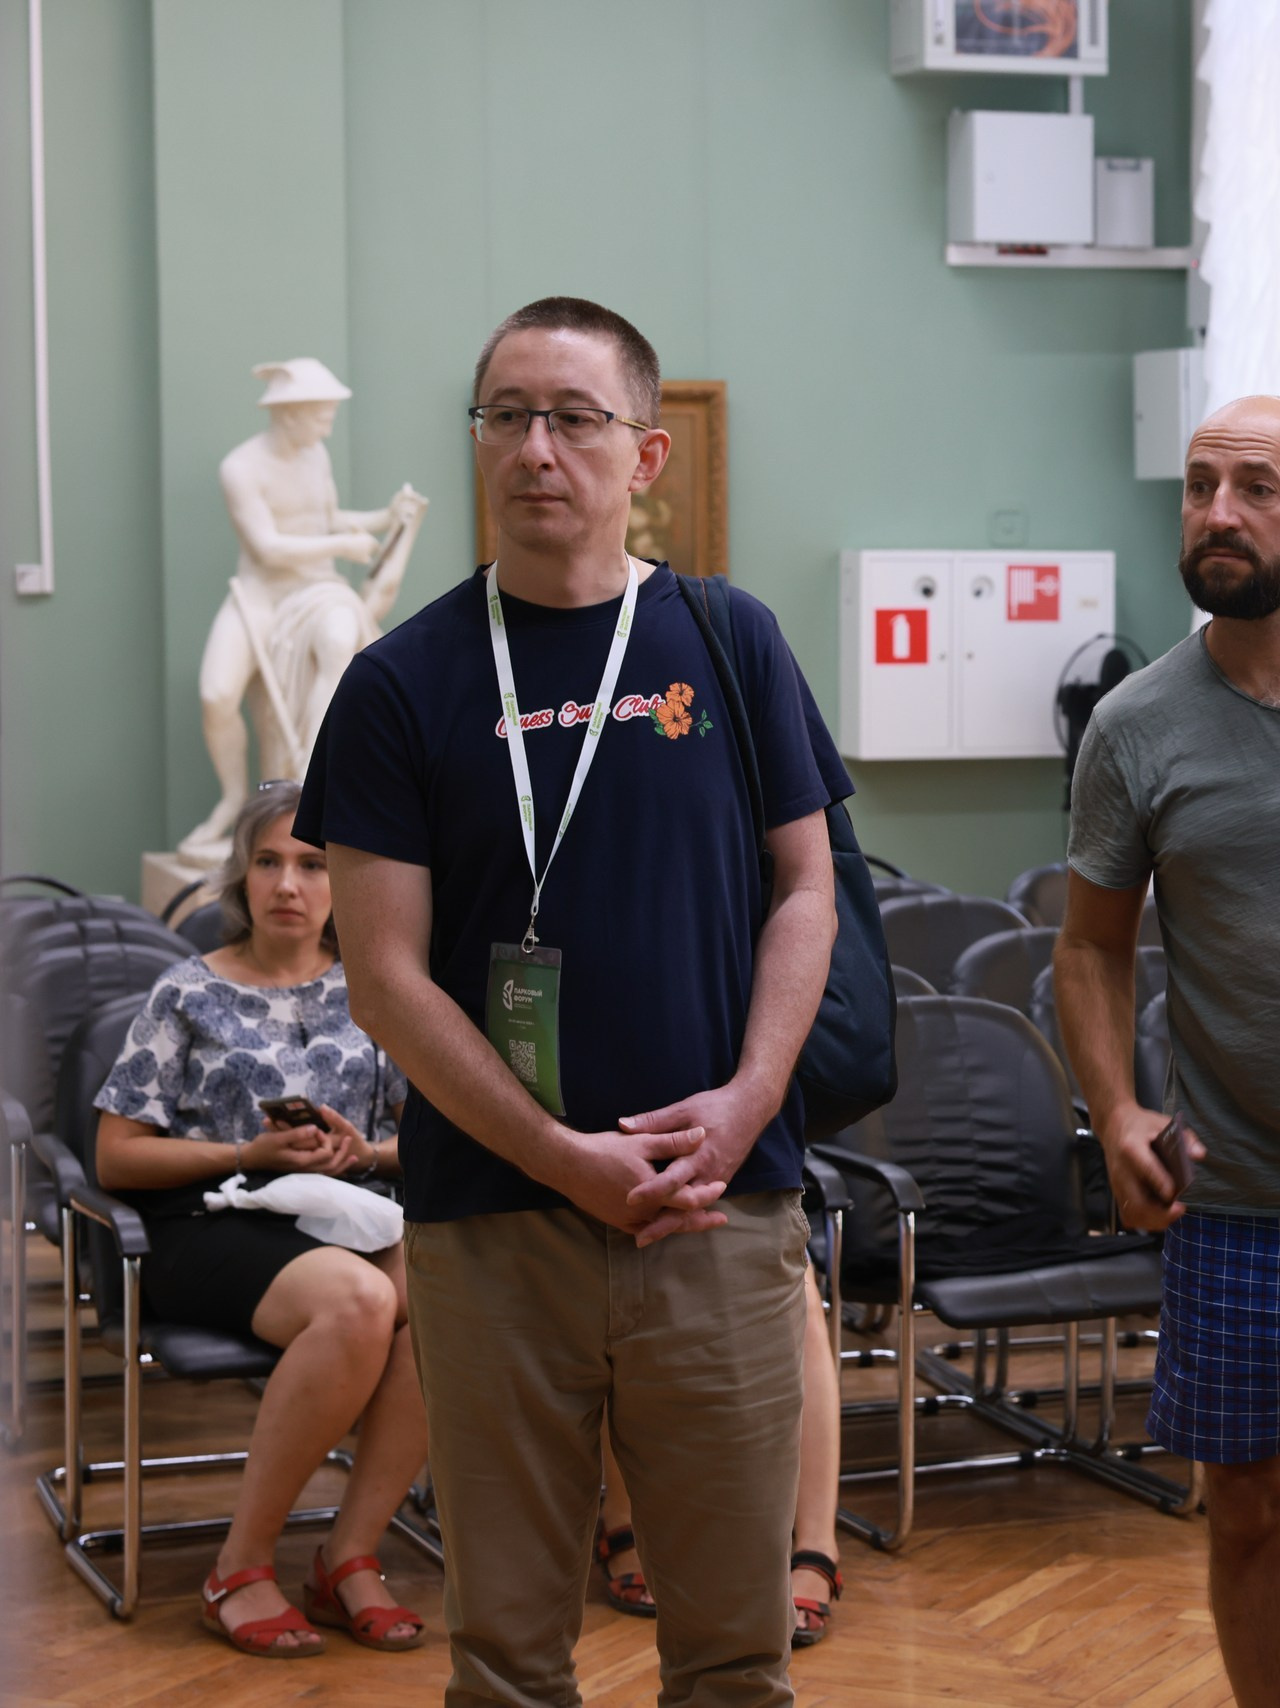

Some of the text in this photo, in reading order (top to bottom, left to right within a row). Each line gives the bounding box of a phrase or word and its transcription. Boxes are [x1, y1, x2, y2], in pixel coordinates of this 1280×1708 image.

[612, 694, 666, 721] Club
[514, 988, 543, 998] ПАРКОВЫЙ
[514, 995, 533, 1004] ФОРУМ
